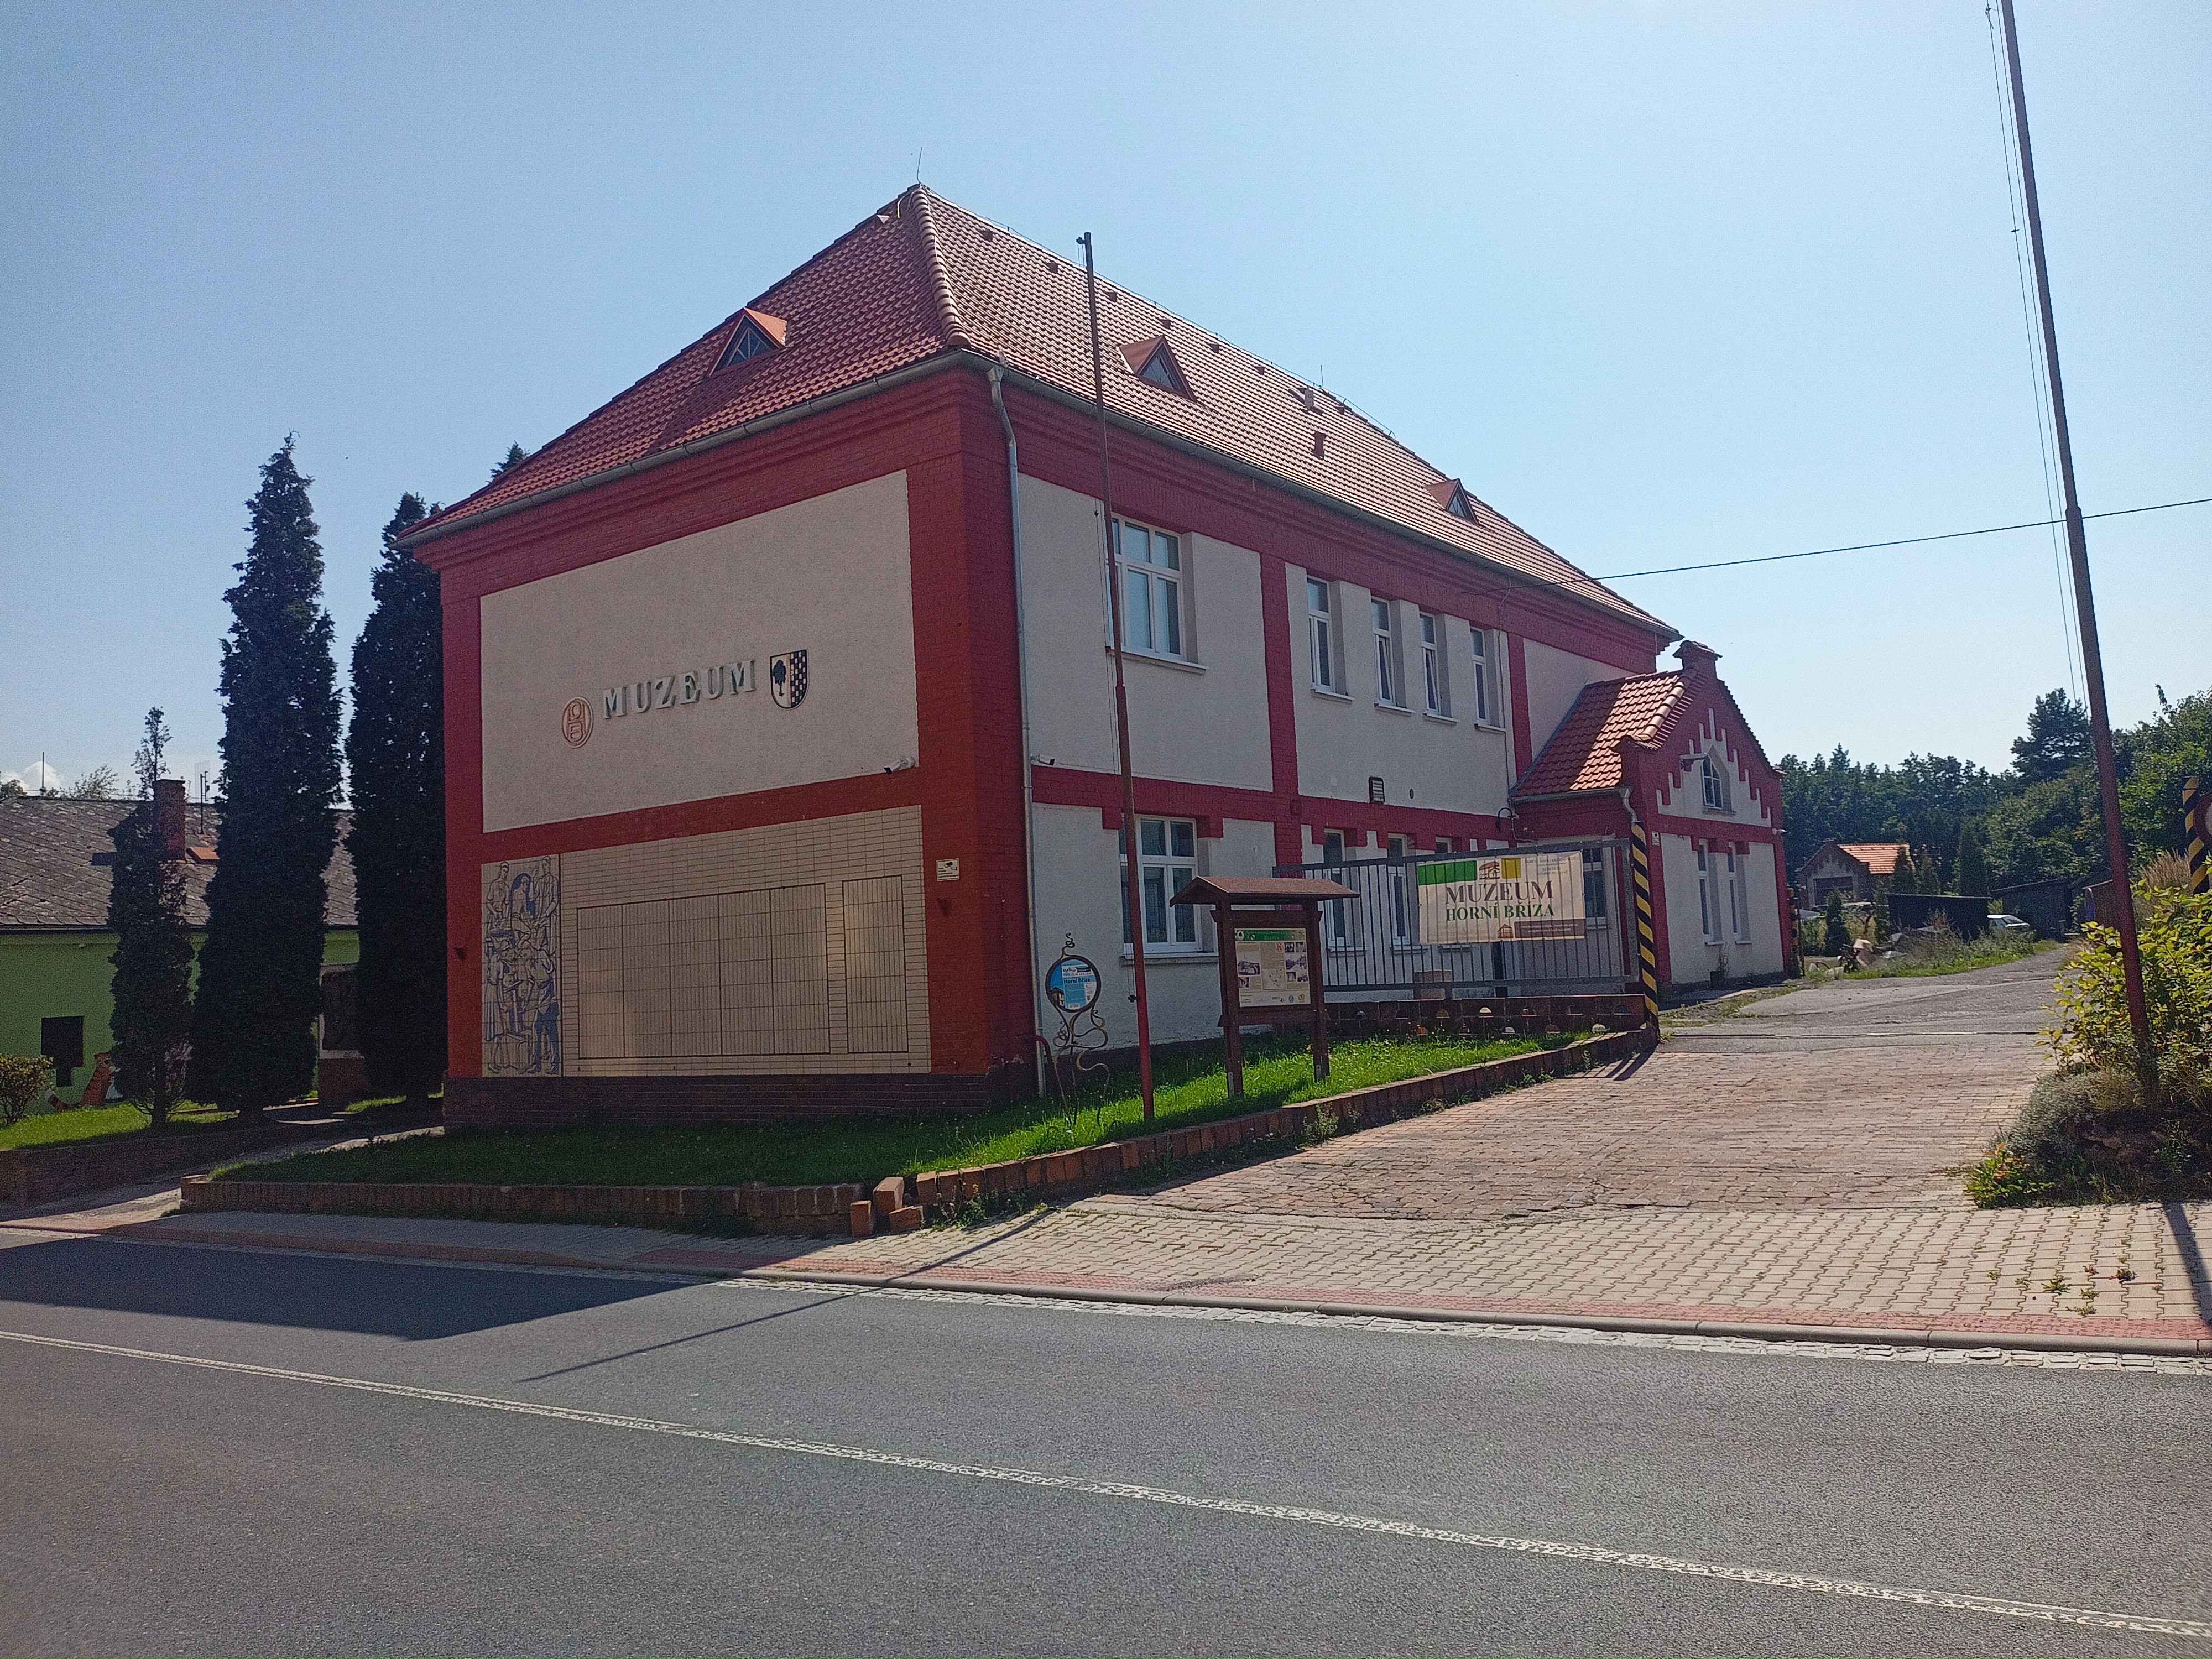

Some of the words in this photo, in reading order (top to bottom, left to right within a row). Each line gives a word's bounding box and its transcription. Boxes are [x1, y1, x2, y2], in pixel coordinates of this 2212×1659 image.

[603, 659, 756, 719] MUZEUM
[1445, 880, 1553, 904] MUZEUM
[1446, 902, 1498, 921] HORNÍ
[1504, 901, 1554, 918] BŘÍZA
